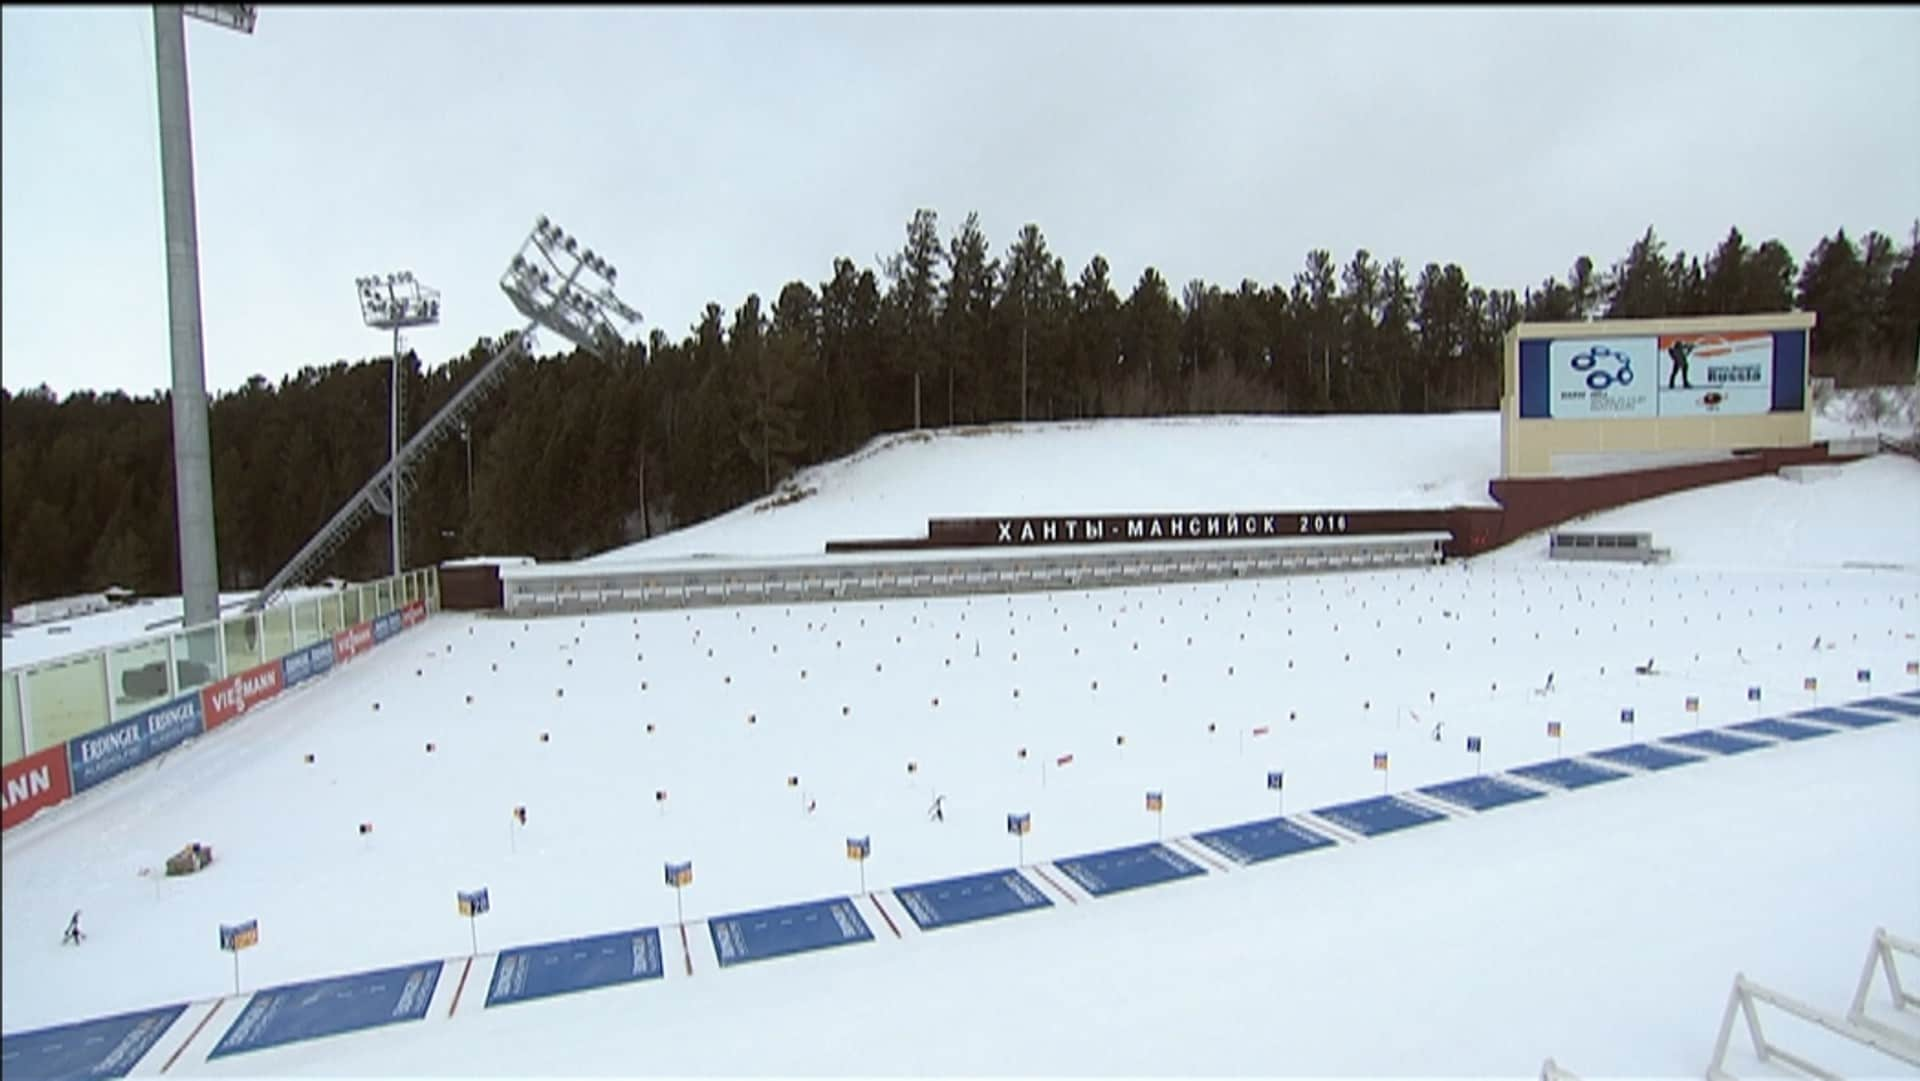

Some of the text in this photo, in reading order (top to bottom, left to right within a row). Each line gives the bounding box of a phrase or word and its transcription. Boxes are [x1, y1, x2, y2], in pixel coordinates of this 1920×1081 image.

[1300, 515, 1347, 533] 2016
[212, 671, 277, 712] VIESSMANN
[82, 725, 140, 763] ERDINGER
[147, 702, 195, 734] ERDINGER
